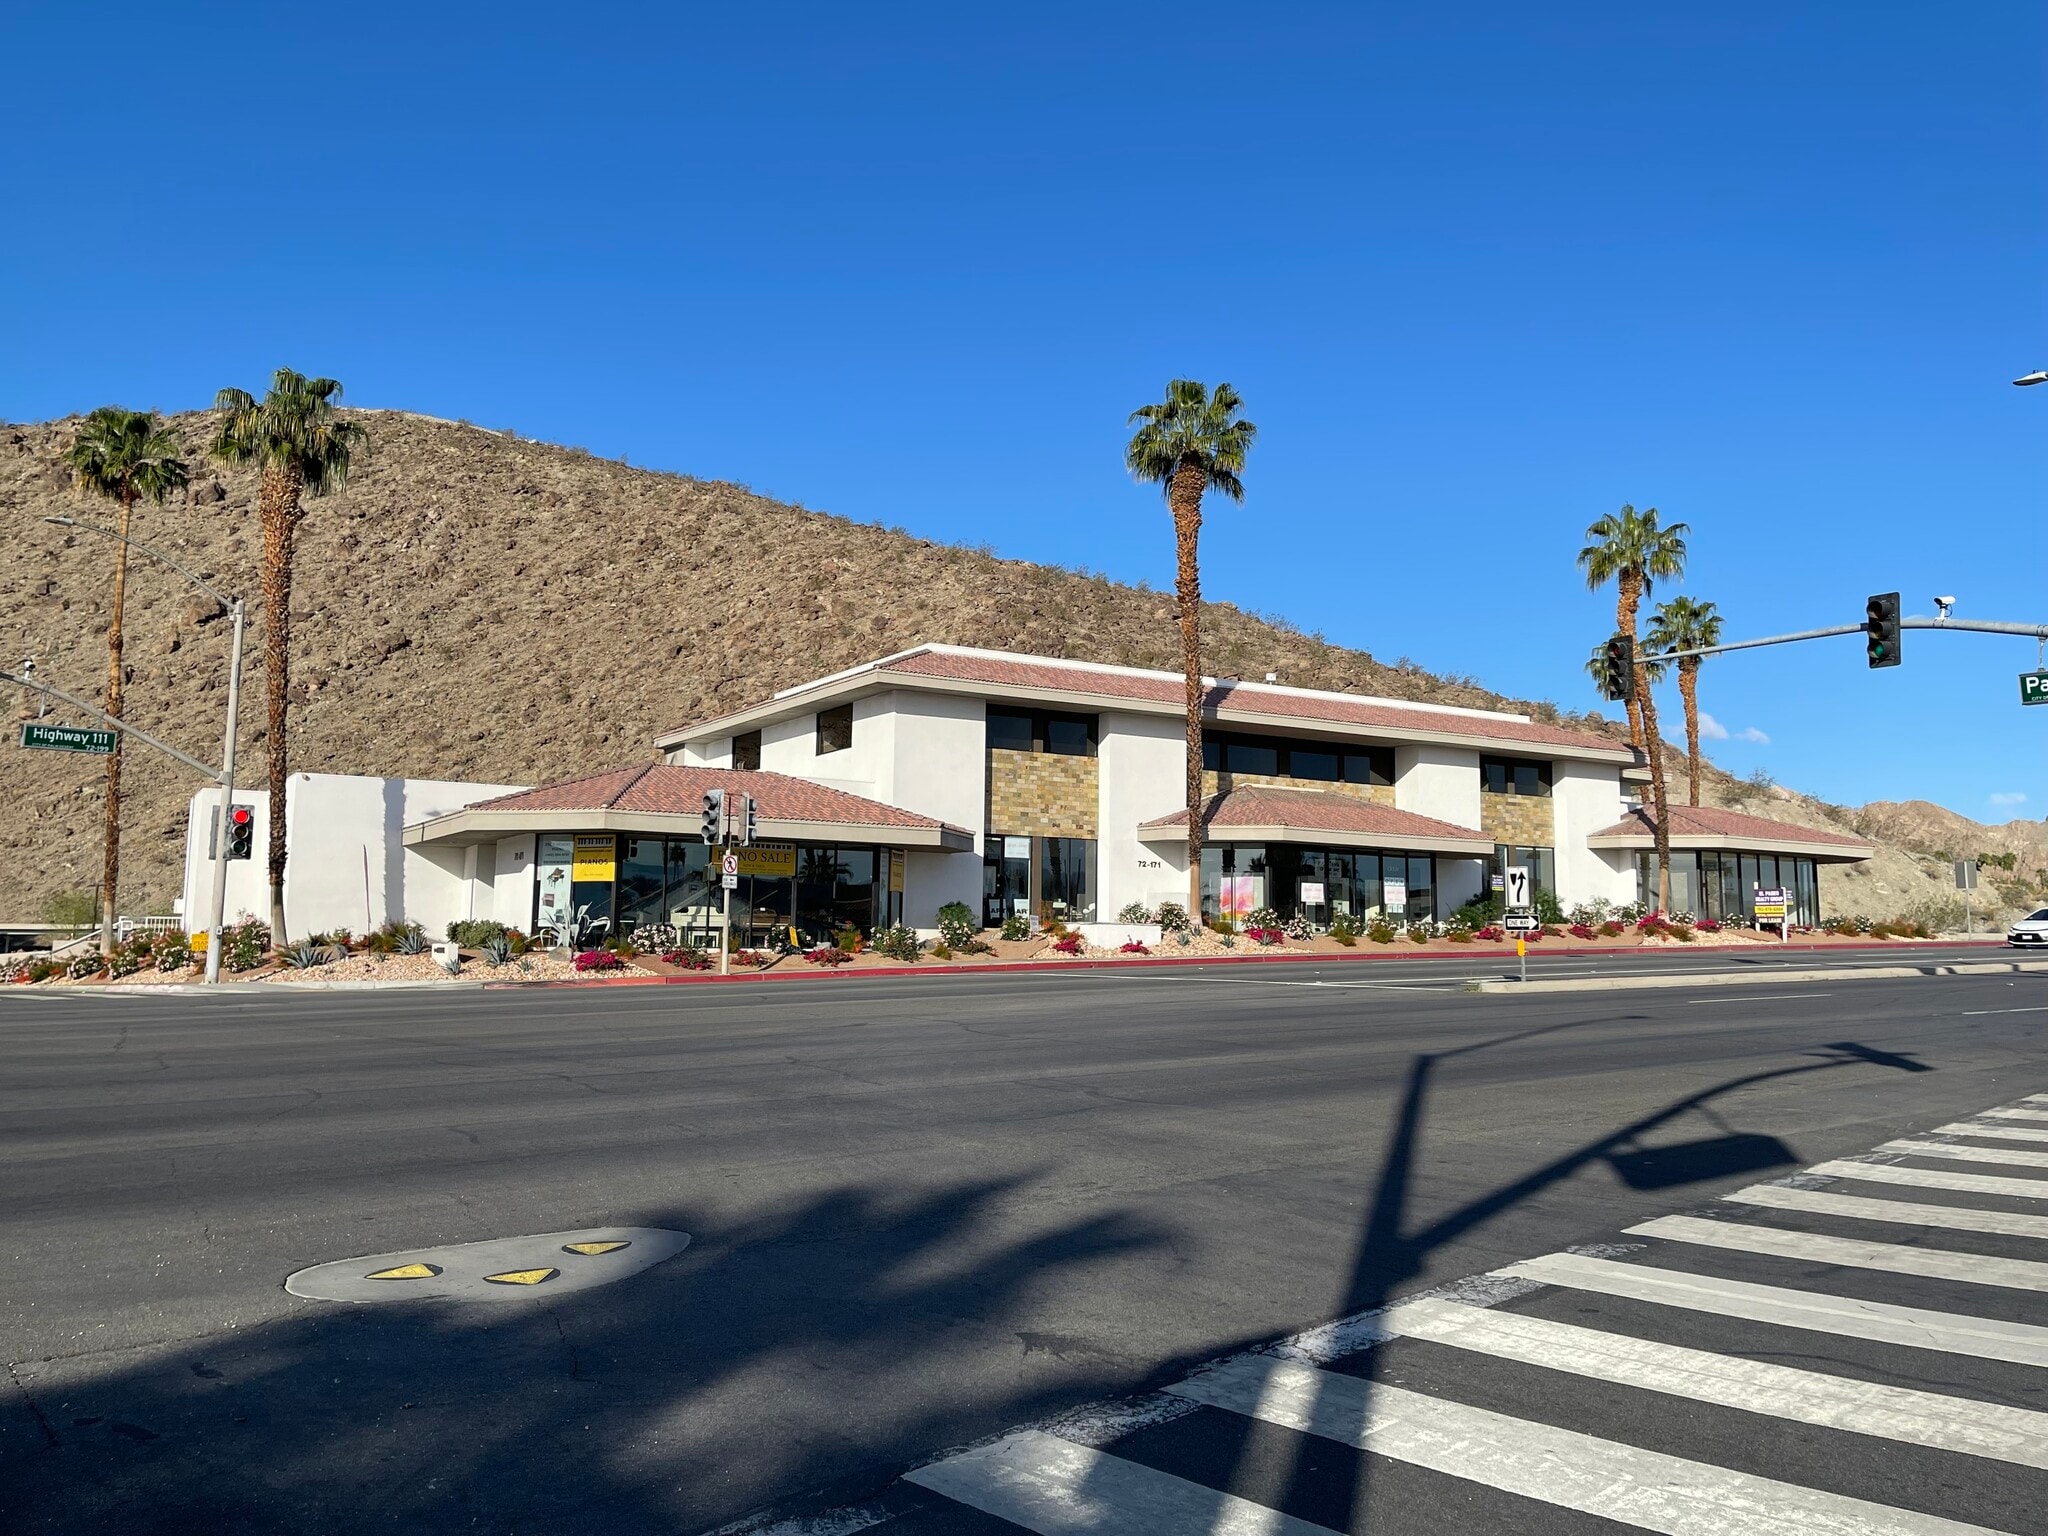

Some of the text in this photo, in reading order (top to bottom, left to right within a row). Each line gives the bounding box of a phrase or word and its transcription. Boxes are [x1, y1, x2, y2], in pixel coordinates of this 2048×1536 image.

[33, 728, 108, 744] Highway 111
[718, 850, 791, 863] PNO SALE
